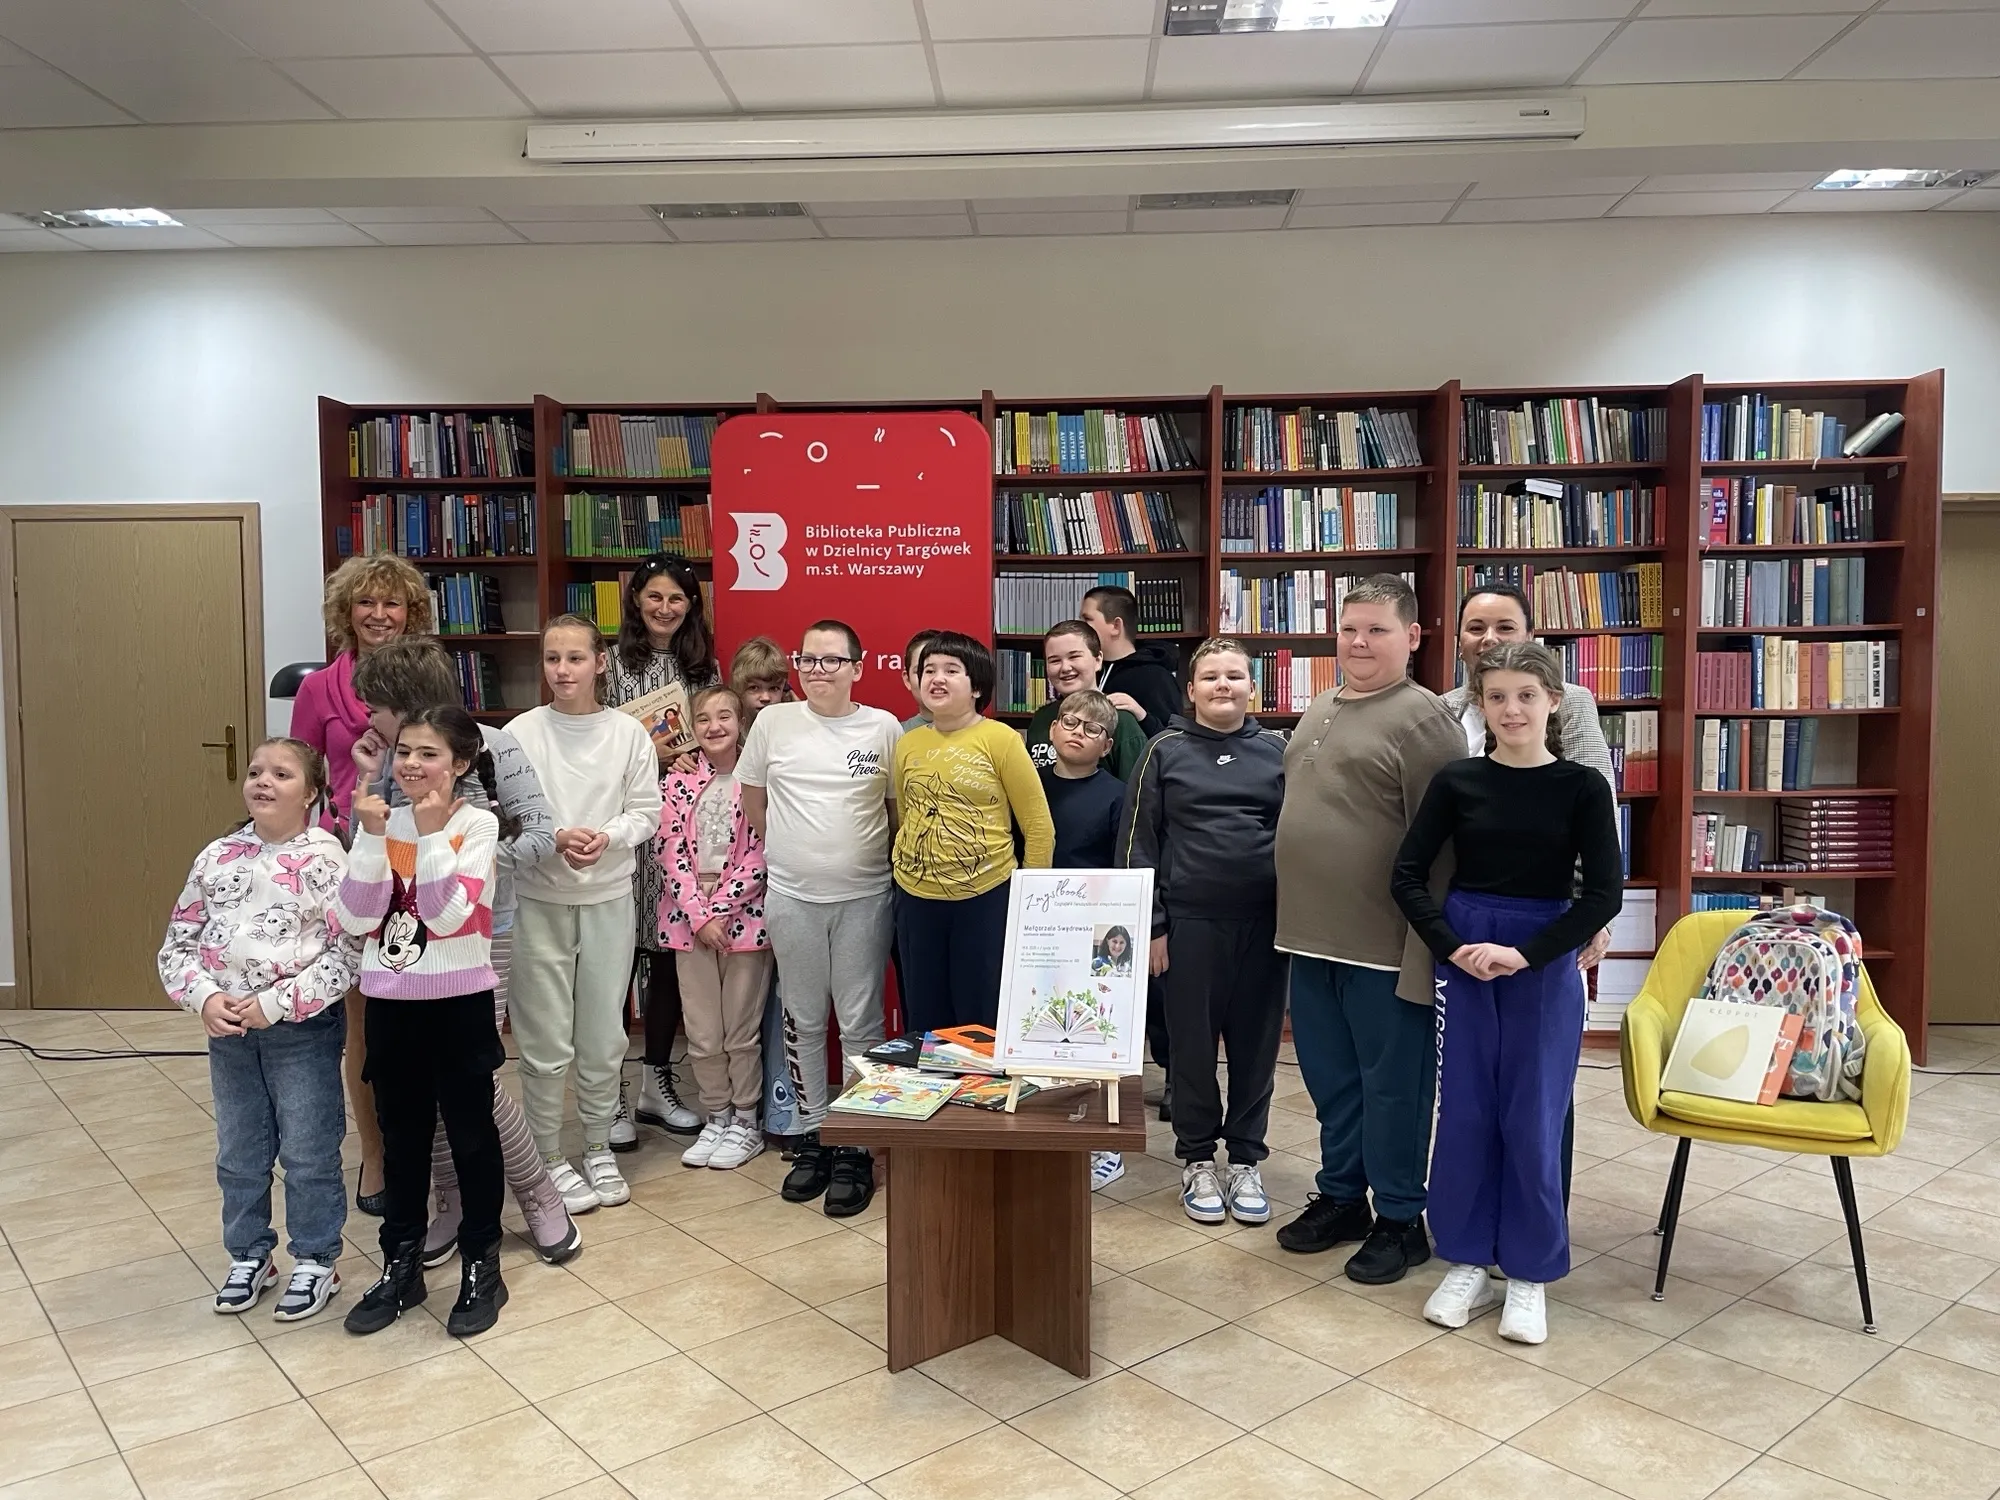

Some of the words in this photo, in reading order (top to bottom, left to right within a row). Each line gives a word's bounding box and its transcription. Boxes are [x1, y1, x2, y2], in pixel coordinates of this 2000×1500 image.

[805, 525, 883, 538] Biblioteka
[888, 524, 961, 538] Publiczna
[805, 547, 818, 557] w
[823, 544, 892, 560] Dzielnicy
[896, 542, 971, 559] Targówek
[805, 564, 844, 576] m.st.
[848, 562, 925, 578] Warszawy
[846, 749, 880, 766] Palm
[949, 763, 988, 779] your
[953, 771, 991, 791] hear
